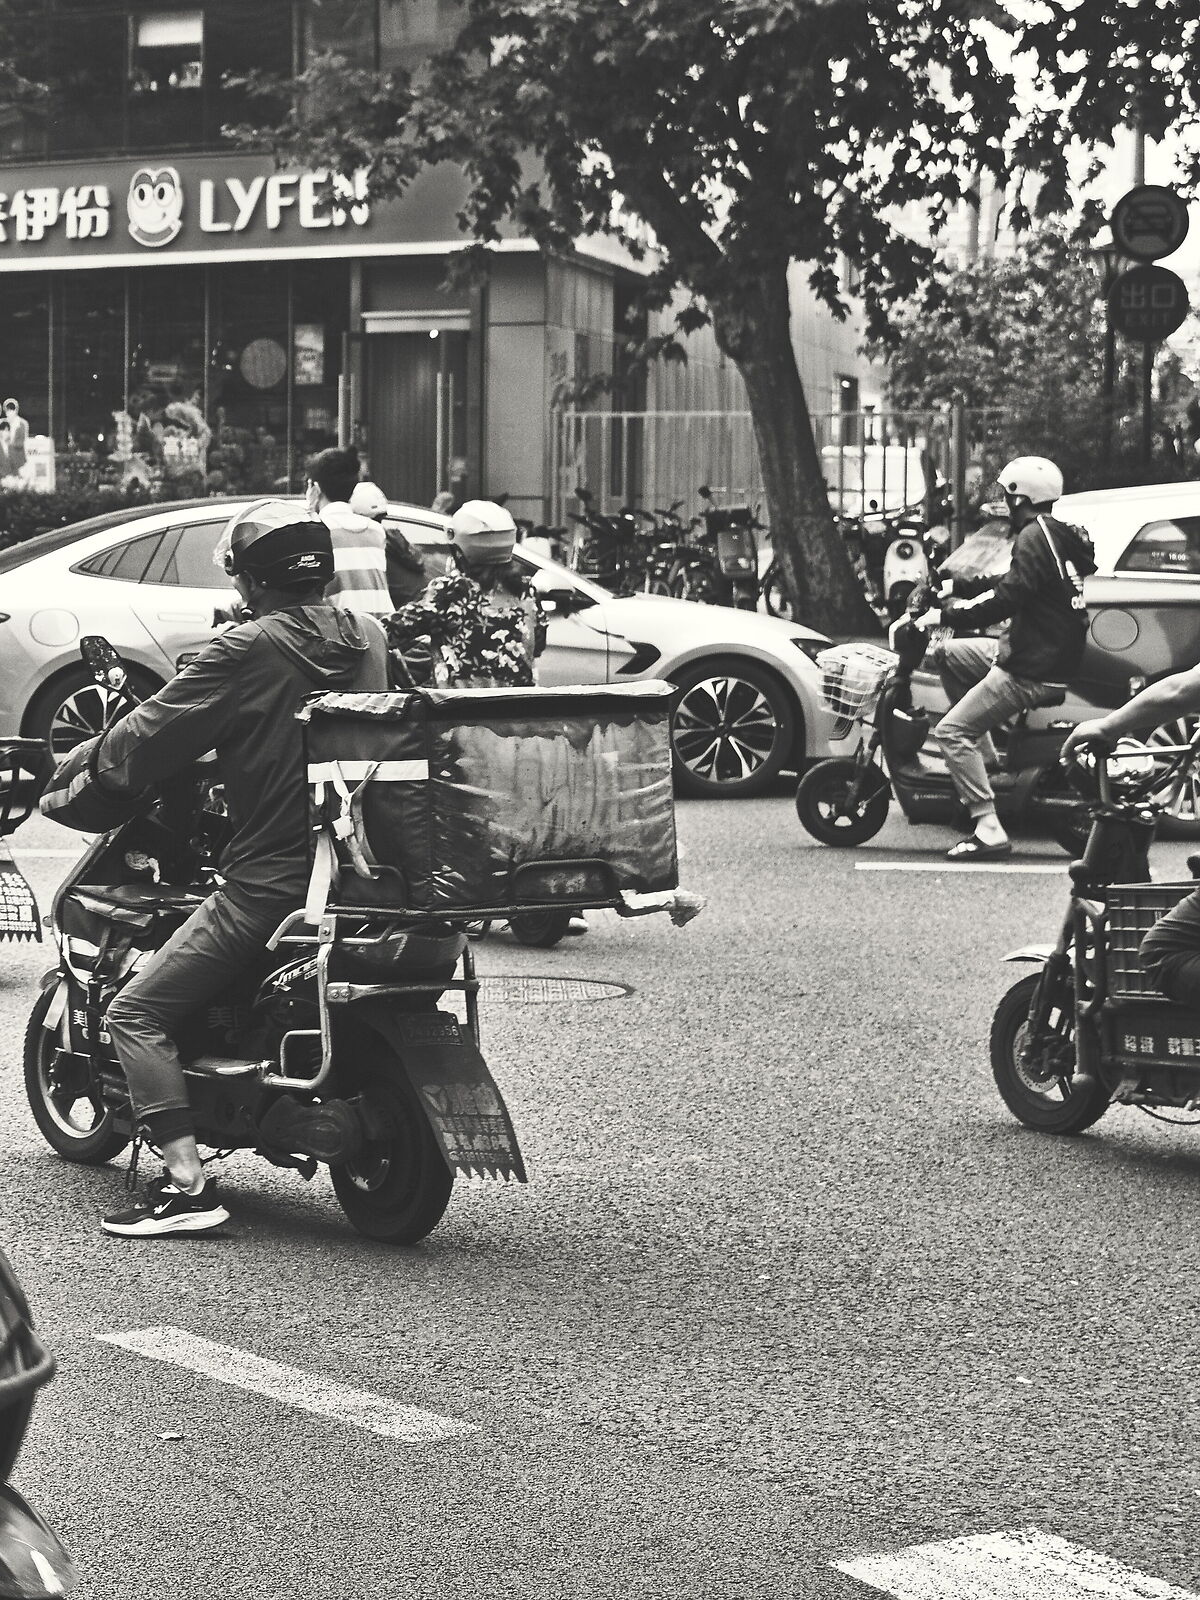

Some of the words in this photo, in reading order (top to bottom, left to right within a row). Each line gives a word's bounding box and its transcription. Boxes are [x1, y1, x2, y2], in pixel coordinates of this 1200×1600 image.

[200, 166, 370, 232] LYFEN
[1120, 283, 1176, 308] 出口
[1125, 312, 1170, 327] EXIT
